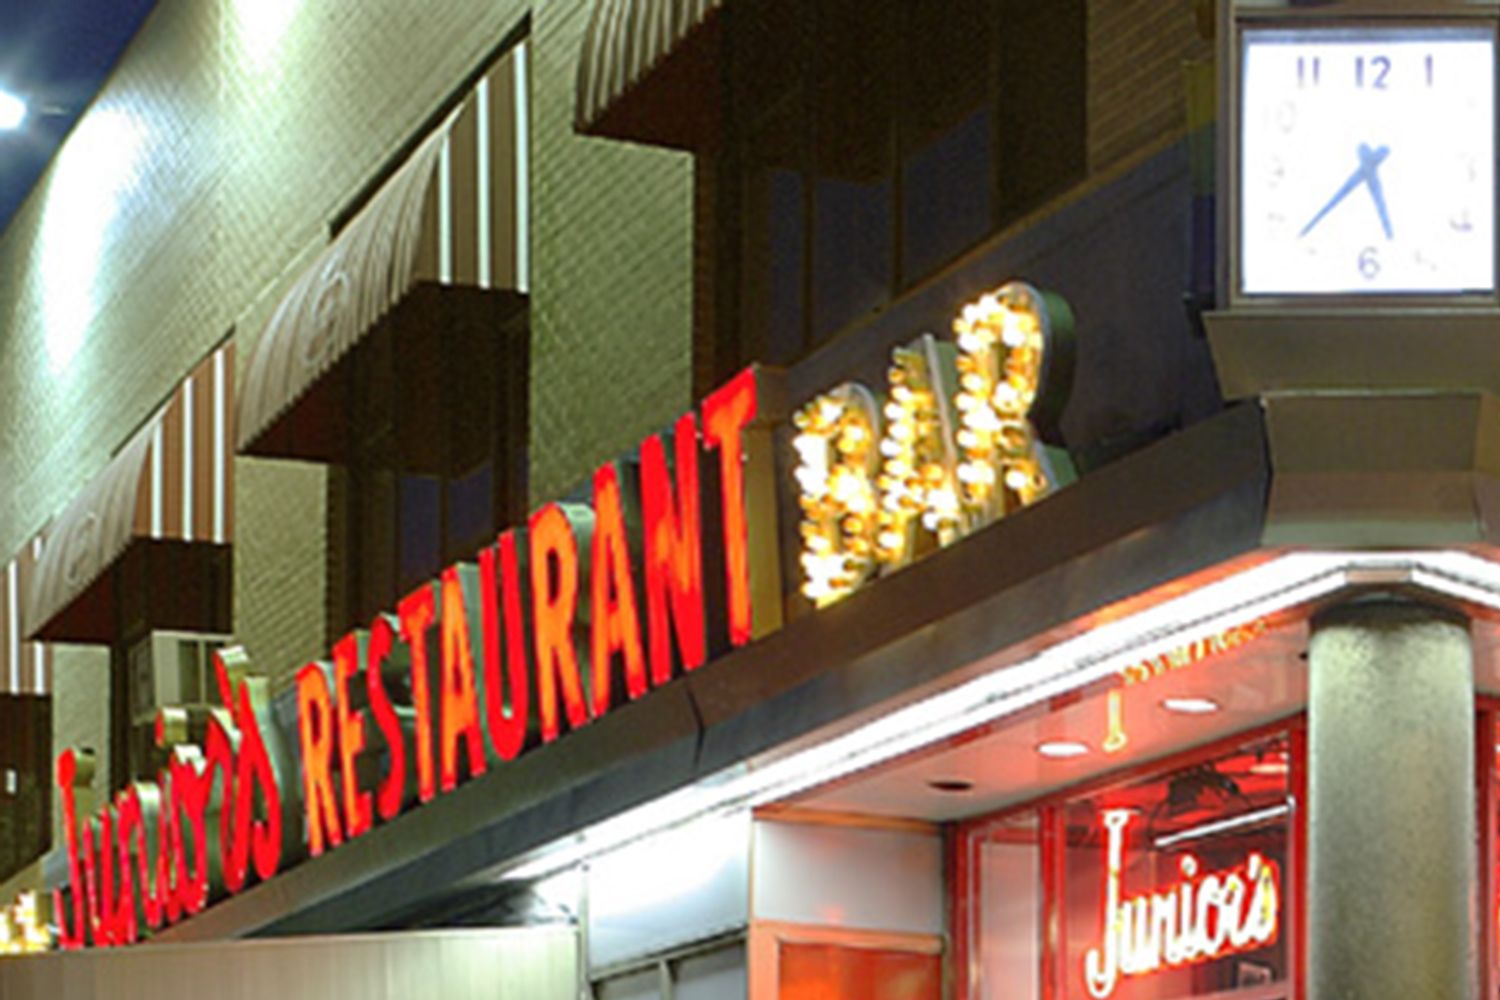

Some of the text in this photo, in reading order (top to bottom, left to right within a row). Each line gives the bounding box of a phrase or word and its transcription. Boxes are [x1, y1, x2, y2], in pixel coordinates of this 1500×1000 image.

[1355, 55, 1392, 90] 12
[1424, 53, 1434, 88] 1
[1357, 245, 1381, 280] 6
[793, 281, 1056, 608] BAR
[295, 365, 758, 857] RESTAURANT
[1085, 809, 1279, 999] Junior's
